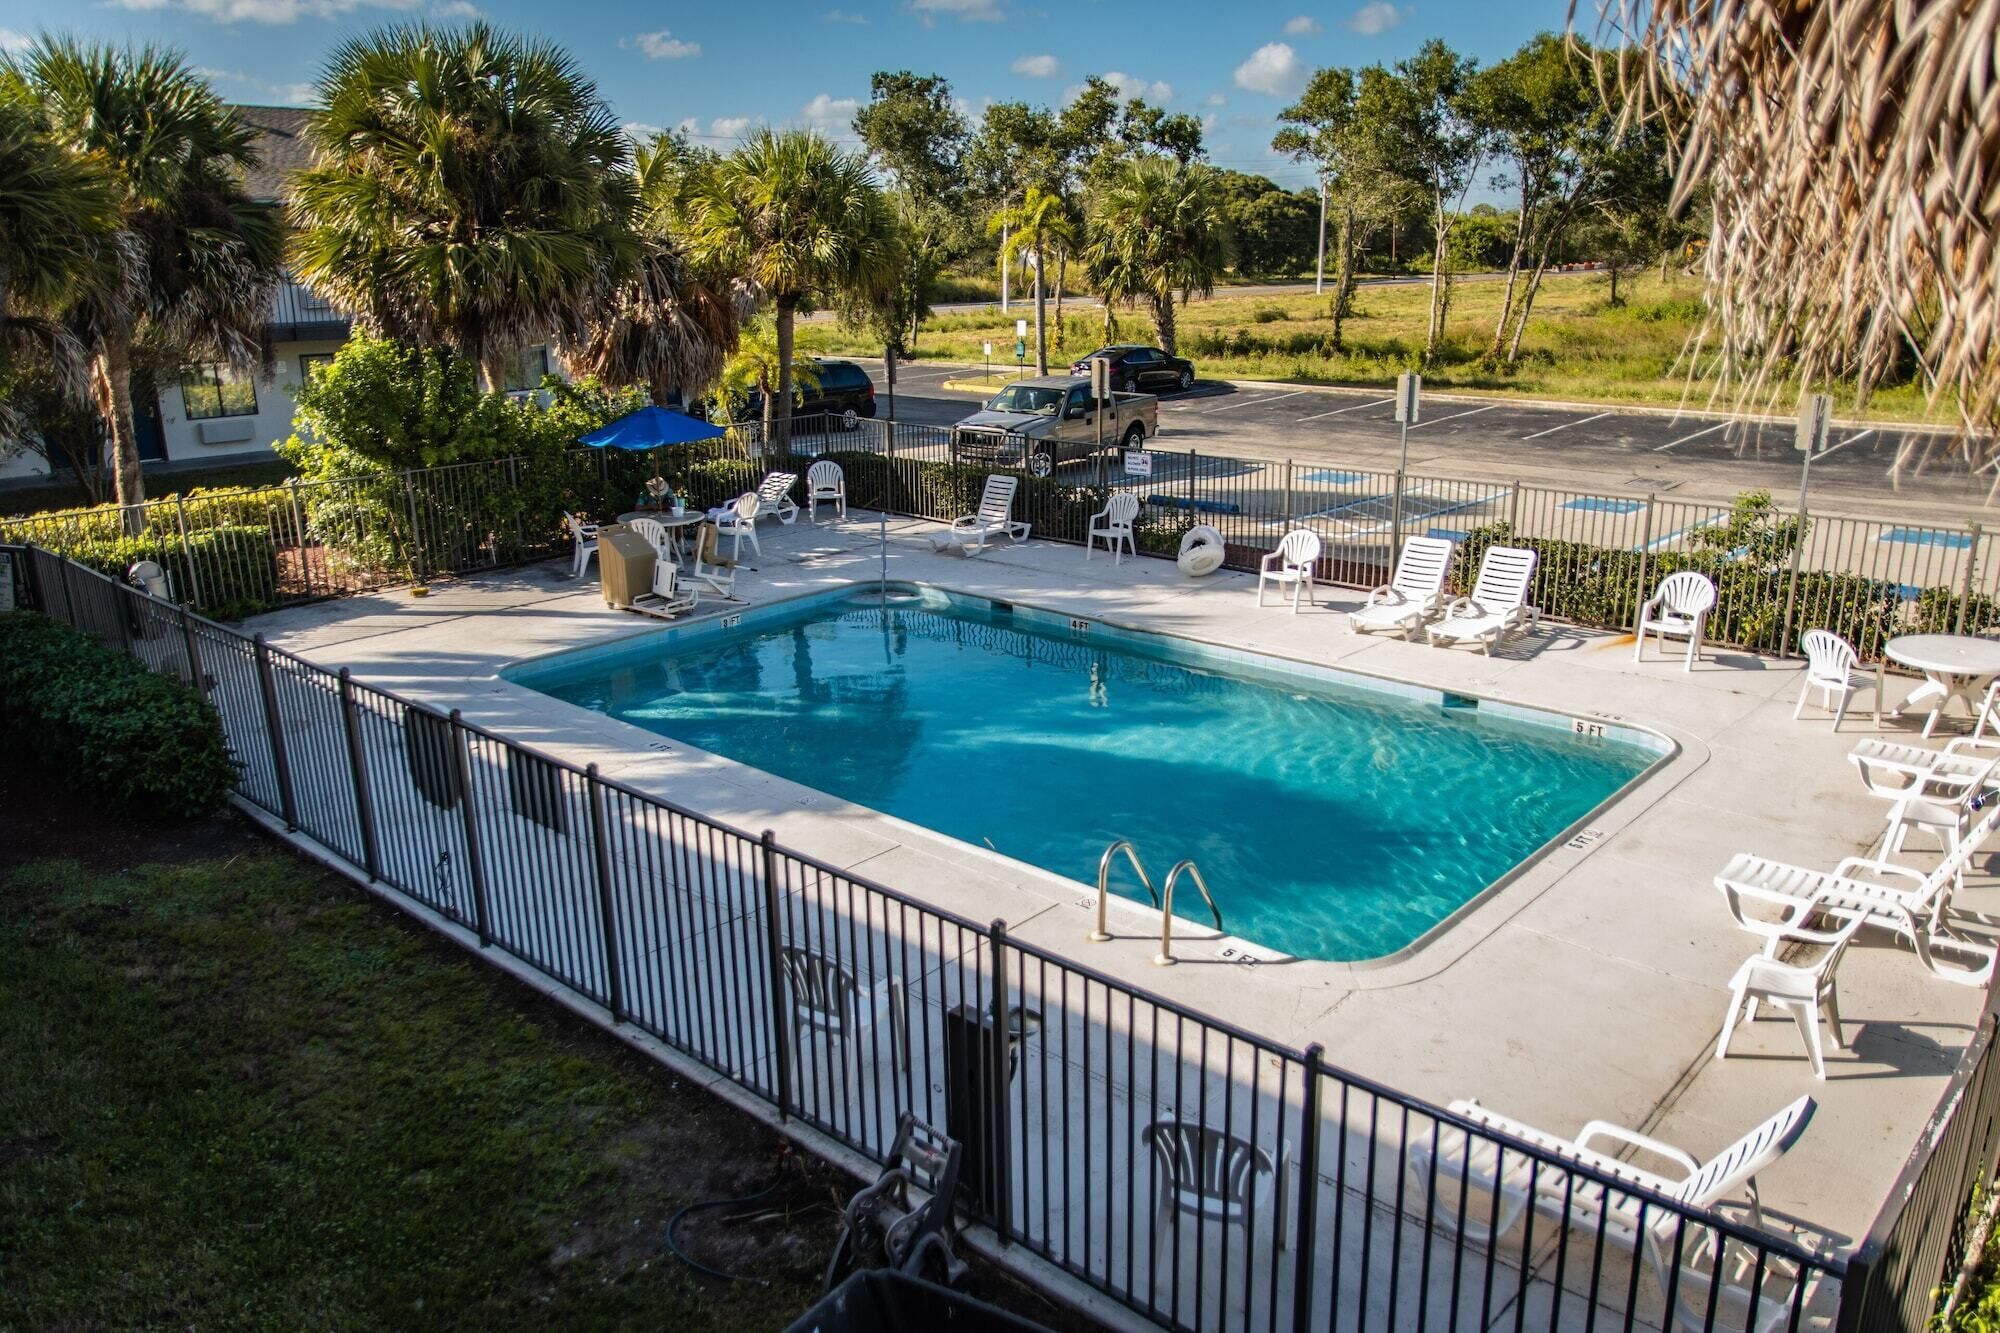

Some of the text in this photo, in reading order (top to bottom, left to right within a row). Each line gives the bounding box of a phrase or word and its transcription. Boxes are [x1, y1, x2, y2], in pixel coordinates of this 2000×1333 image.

[731, 615, 740, 625] FT
[1071, 620, 1089, 630] 4 FT
[1576, 721, 1603, 737] 5 FT
[1575, 835, 1594, 845] FT
[1222, 948, 1238, 957] 5
